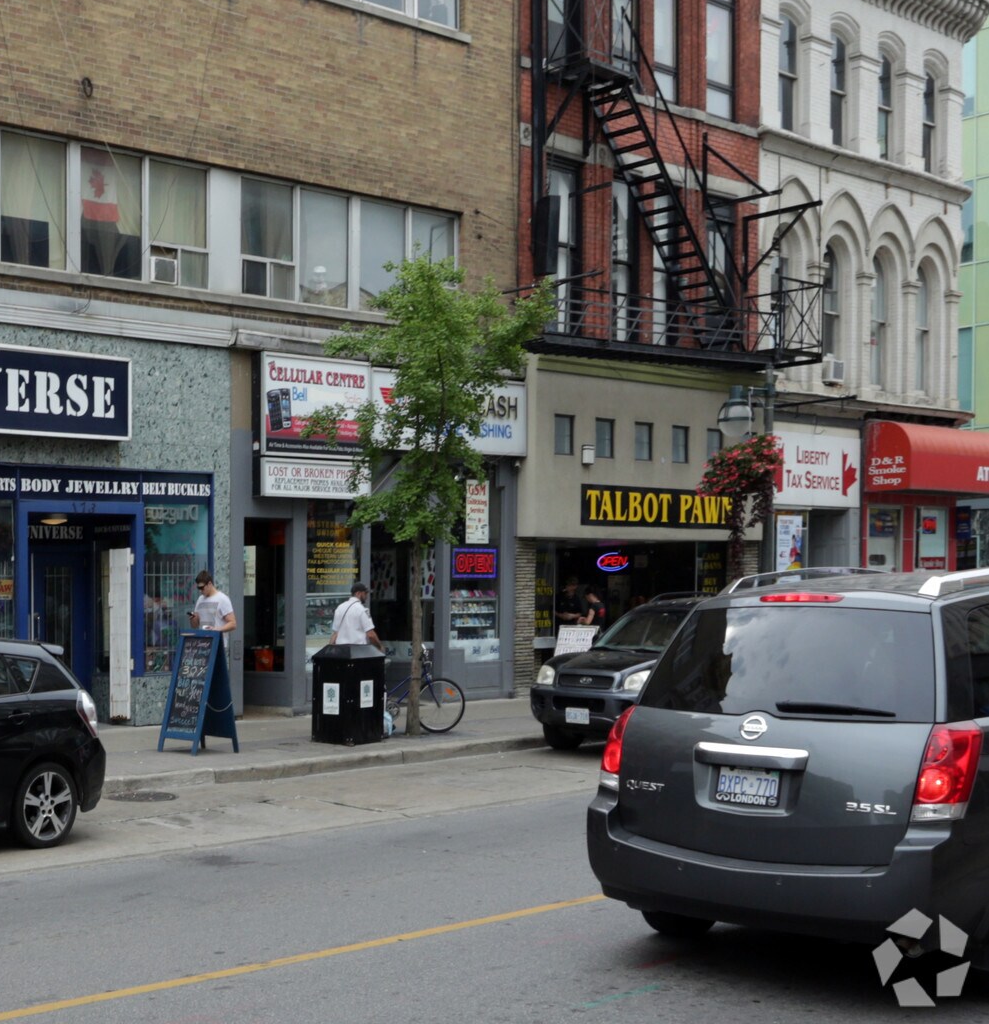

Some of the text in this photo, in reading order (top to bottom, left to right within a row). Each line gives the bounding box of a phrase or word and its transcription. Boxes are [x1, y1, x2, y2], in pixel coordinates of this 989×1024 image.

[269, 366, 366, 389] CELLULAR CENTRE
[292, 386, 308, 402] Bell
[796, 445, 830, 466] LIBERTY
[268, 466, 289, 477] LOST
[291, 467, 302, 478] OR
[304, 468, 335, 479] BROKEN
[868, 465, 907, 475] Smoke
[20, 478, 140, 495] BODY JEWELLRY
[785, 470, 841, 490] TAX SERVICE
[872, 476, 902, 486] Shop
[142, 481, 211, 496] BELT BUCKLES
[468, 483, 487, 496] GSM
[586, 489, 673, 523] TALBOT
[28, 525, 84, 540] NIVERSE
[455, 553, 494, 573] OPEN
[600, 556, 629, 566] OPEN
[626, 779, 665, 792] QUEST
[719, 775, 778, 796] BXPC 770
[730, 793, 767, 805] LONDON
[872, 804, 897, 815] SL
